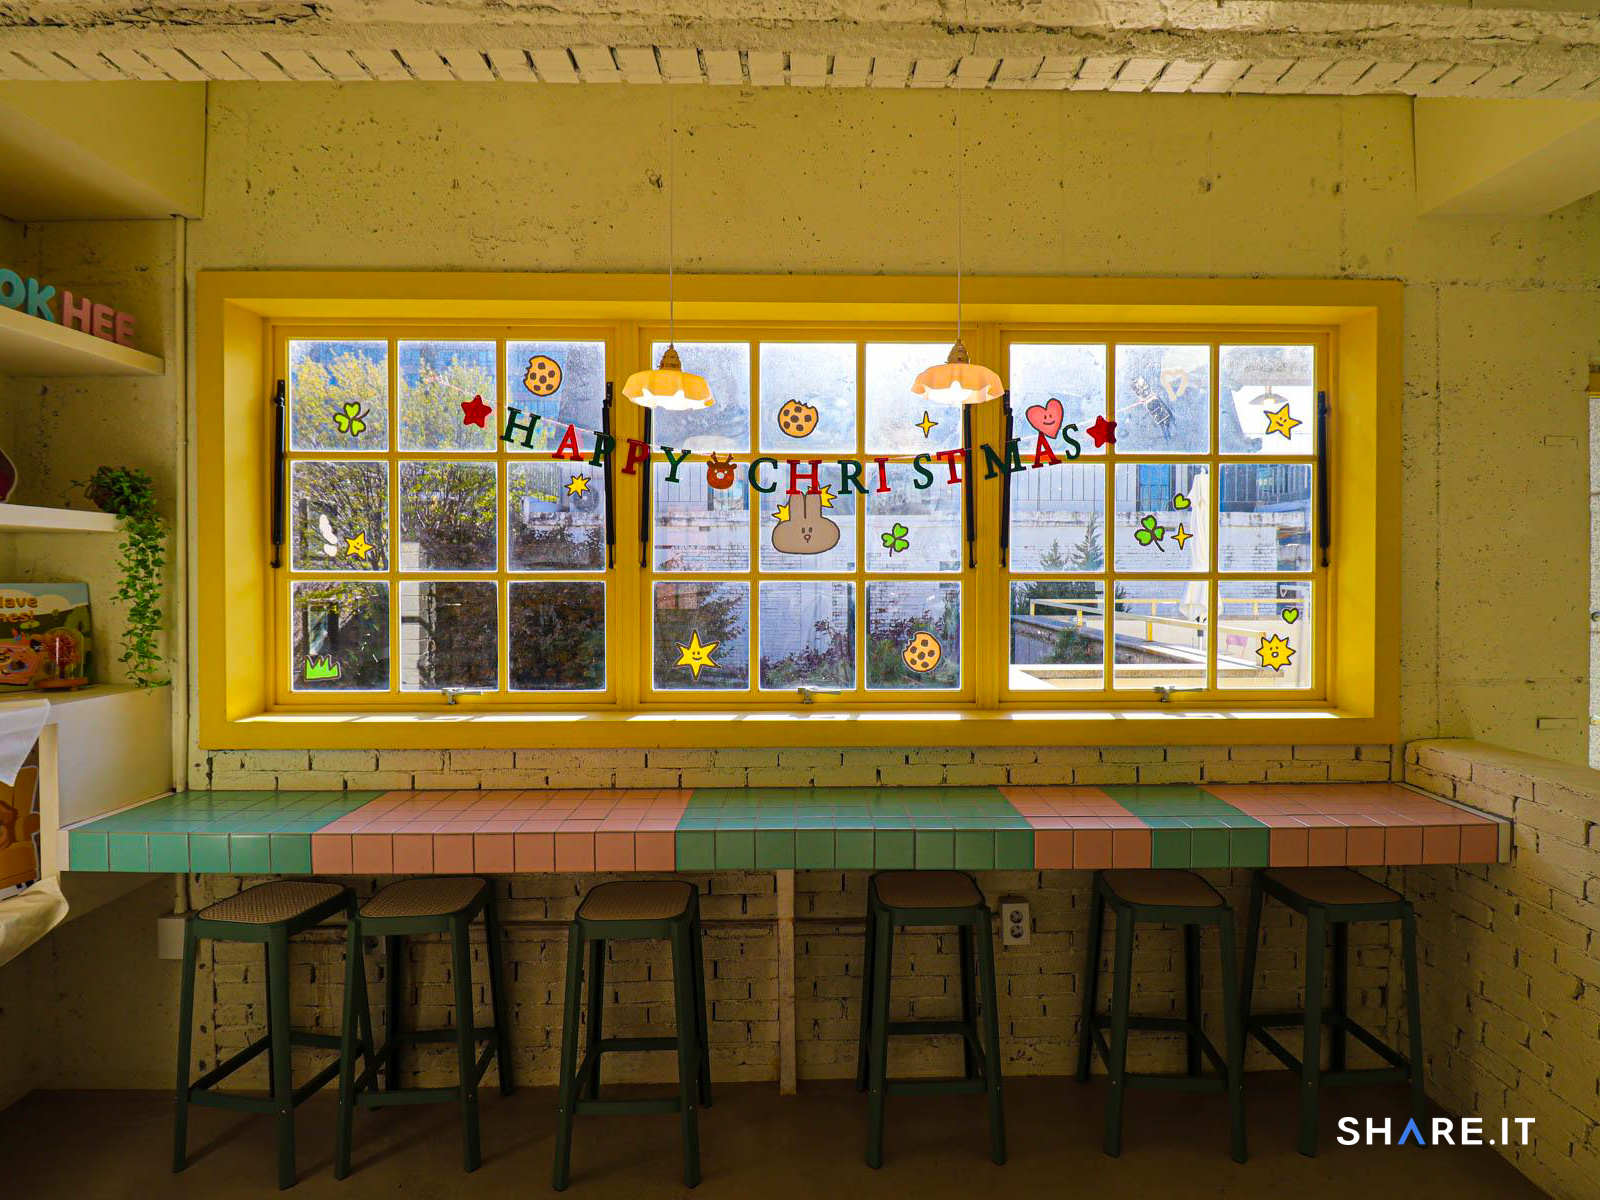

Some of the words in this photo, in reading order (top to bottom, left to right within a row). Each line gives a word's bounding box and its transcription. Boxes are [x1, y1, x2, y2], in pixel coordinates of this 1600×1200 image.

[61, 291, 138, 347] HEE
[500, 406, 691, 483] HAPPY
[748, 424, 1082, 494] CHRISTMAS
